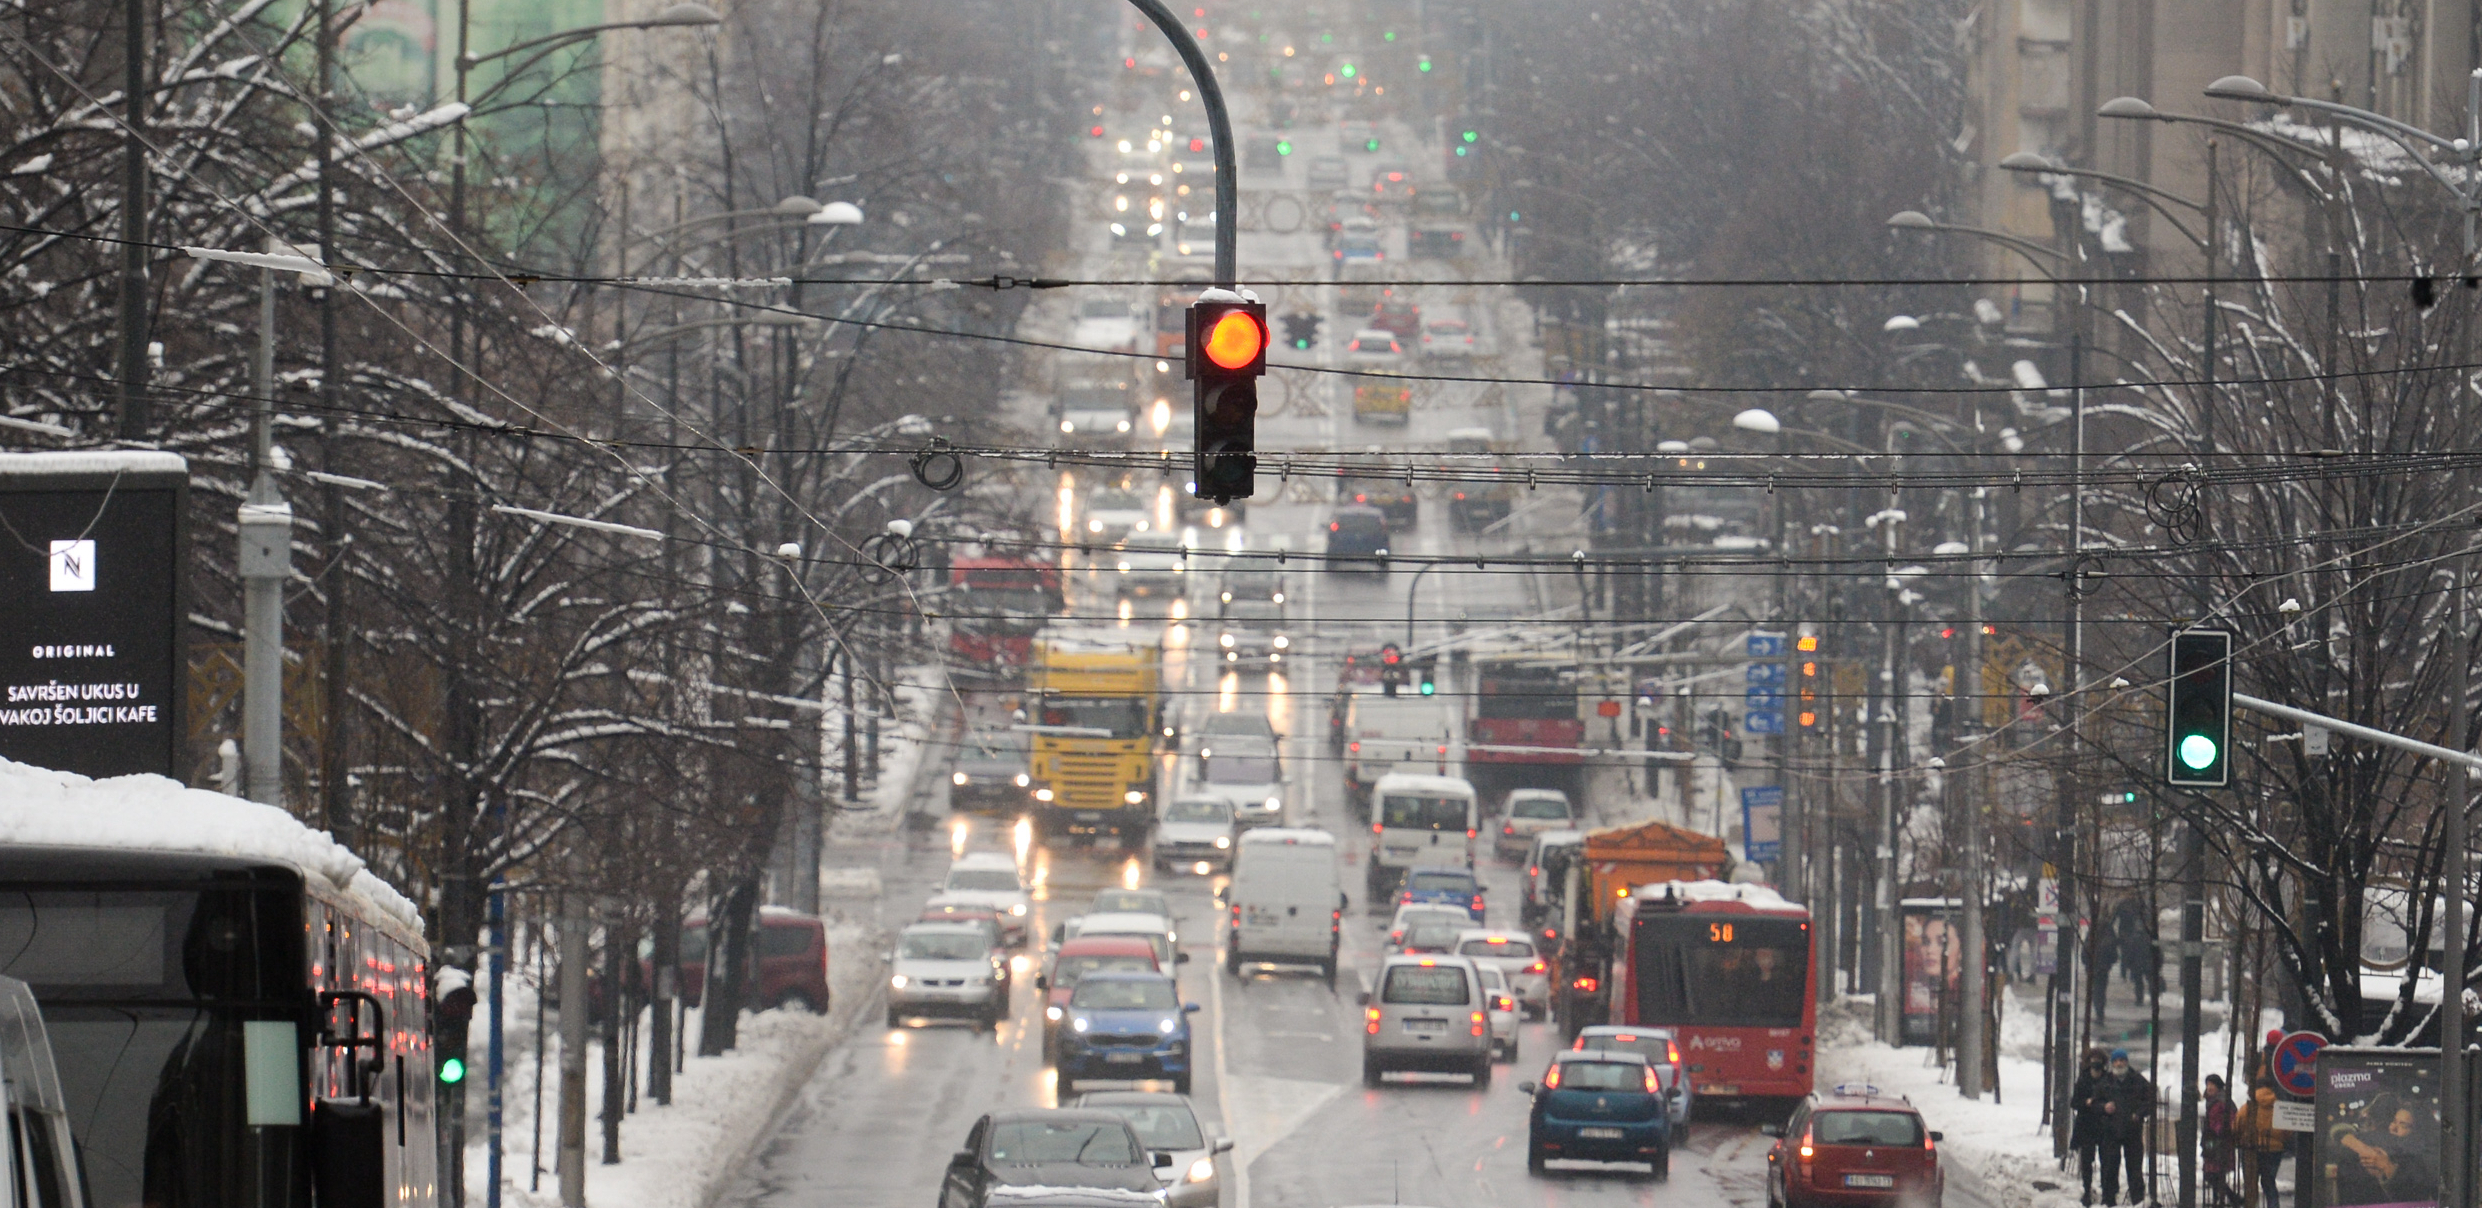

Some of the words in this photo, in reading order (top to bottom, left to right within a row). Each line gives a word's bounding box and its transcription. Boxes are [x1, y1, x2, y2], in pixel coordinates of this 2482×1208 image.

[63, 551, 82, 579] N
[33, 645, 115, 658] ORIGINAL
[8, 680, 79, 702] SAVRŠEN
[82, 683, 124, 700] UKUS
[127, 683, 139, 700] U
[54, 703, 114, 724] ŠOLJICI
[116, 706, 157, 723] KAFE
[1710, 922, 1733, 942] 58
[2331, 1072, 2371, 1086] plazma
